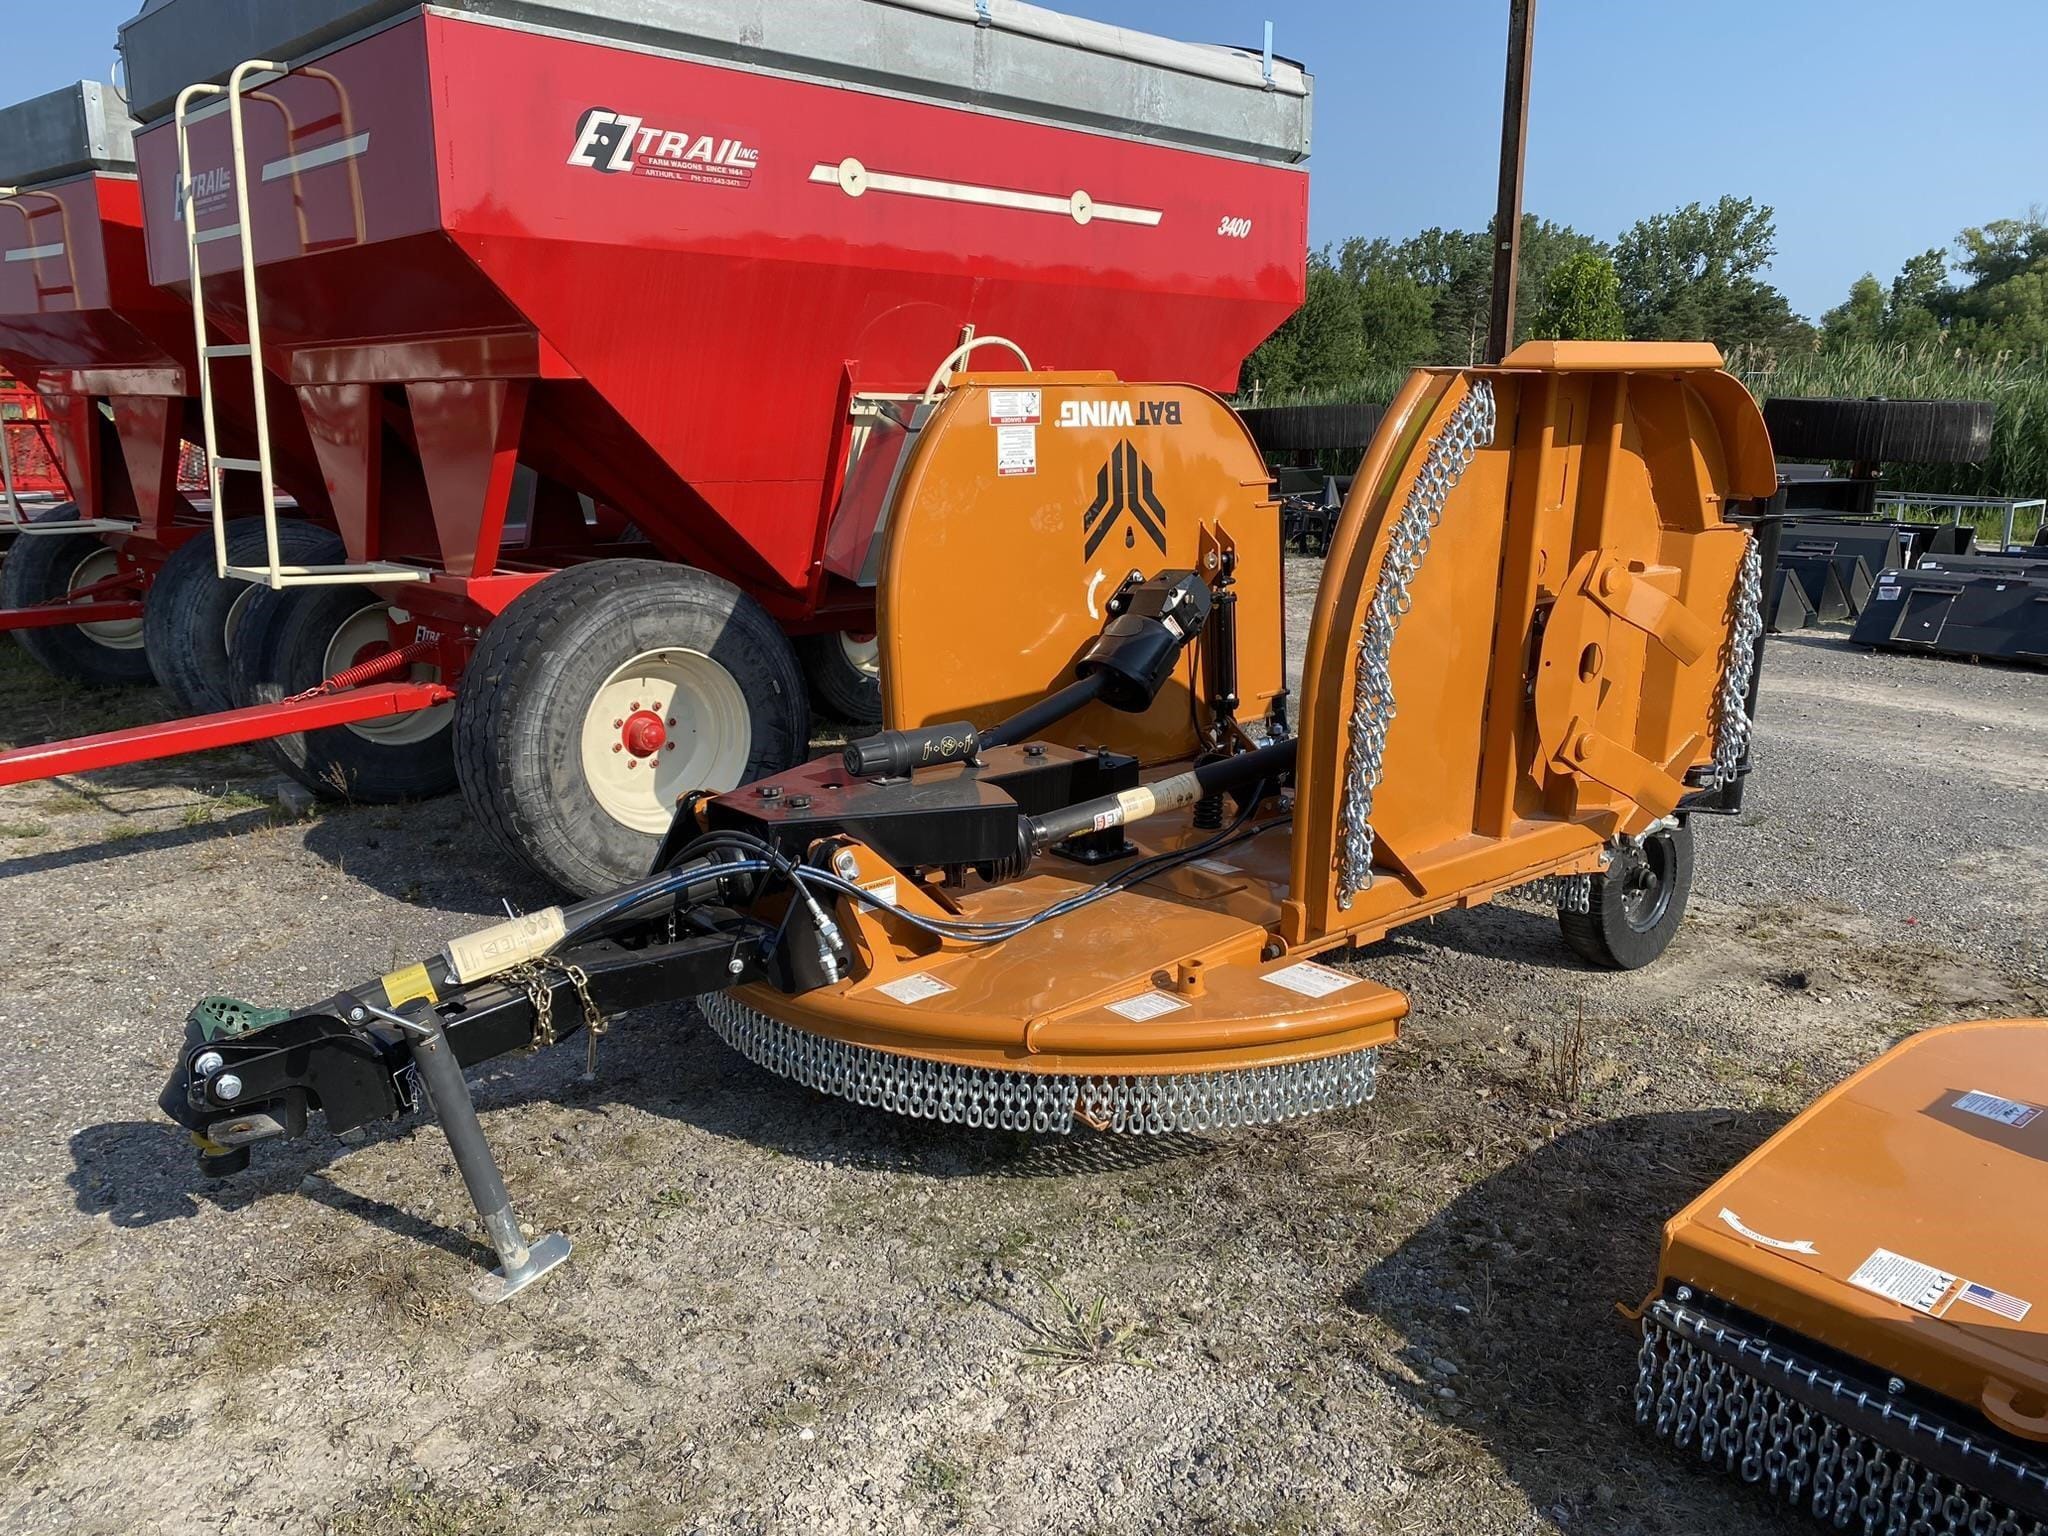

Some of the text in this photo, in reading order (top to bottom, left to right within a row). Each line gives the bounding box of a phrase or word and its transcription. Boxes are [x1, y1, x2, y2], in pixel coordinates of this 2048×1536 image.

[636, 127, 757, 168] TRAIL
[648, 158, 669, 168] FARM
[670, 160, 703, 171] WAGONS
[706, 165, 728, 175] SINCE
[191, 167, 231, 200] TRAIL
[1217, 215, 1252, 239] 3400
[1061, 401, 1183, 427] BAT WING
